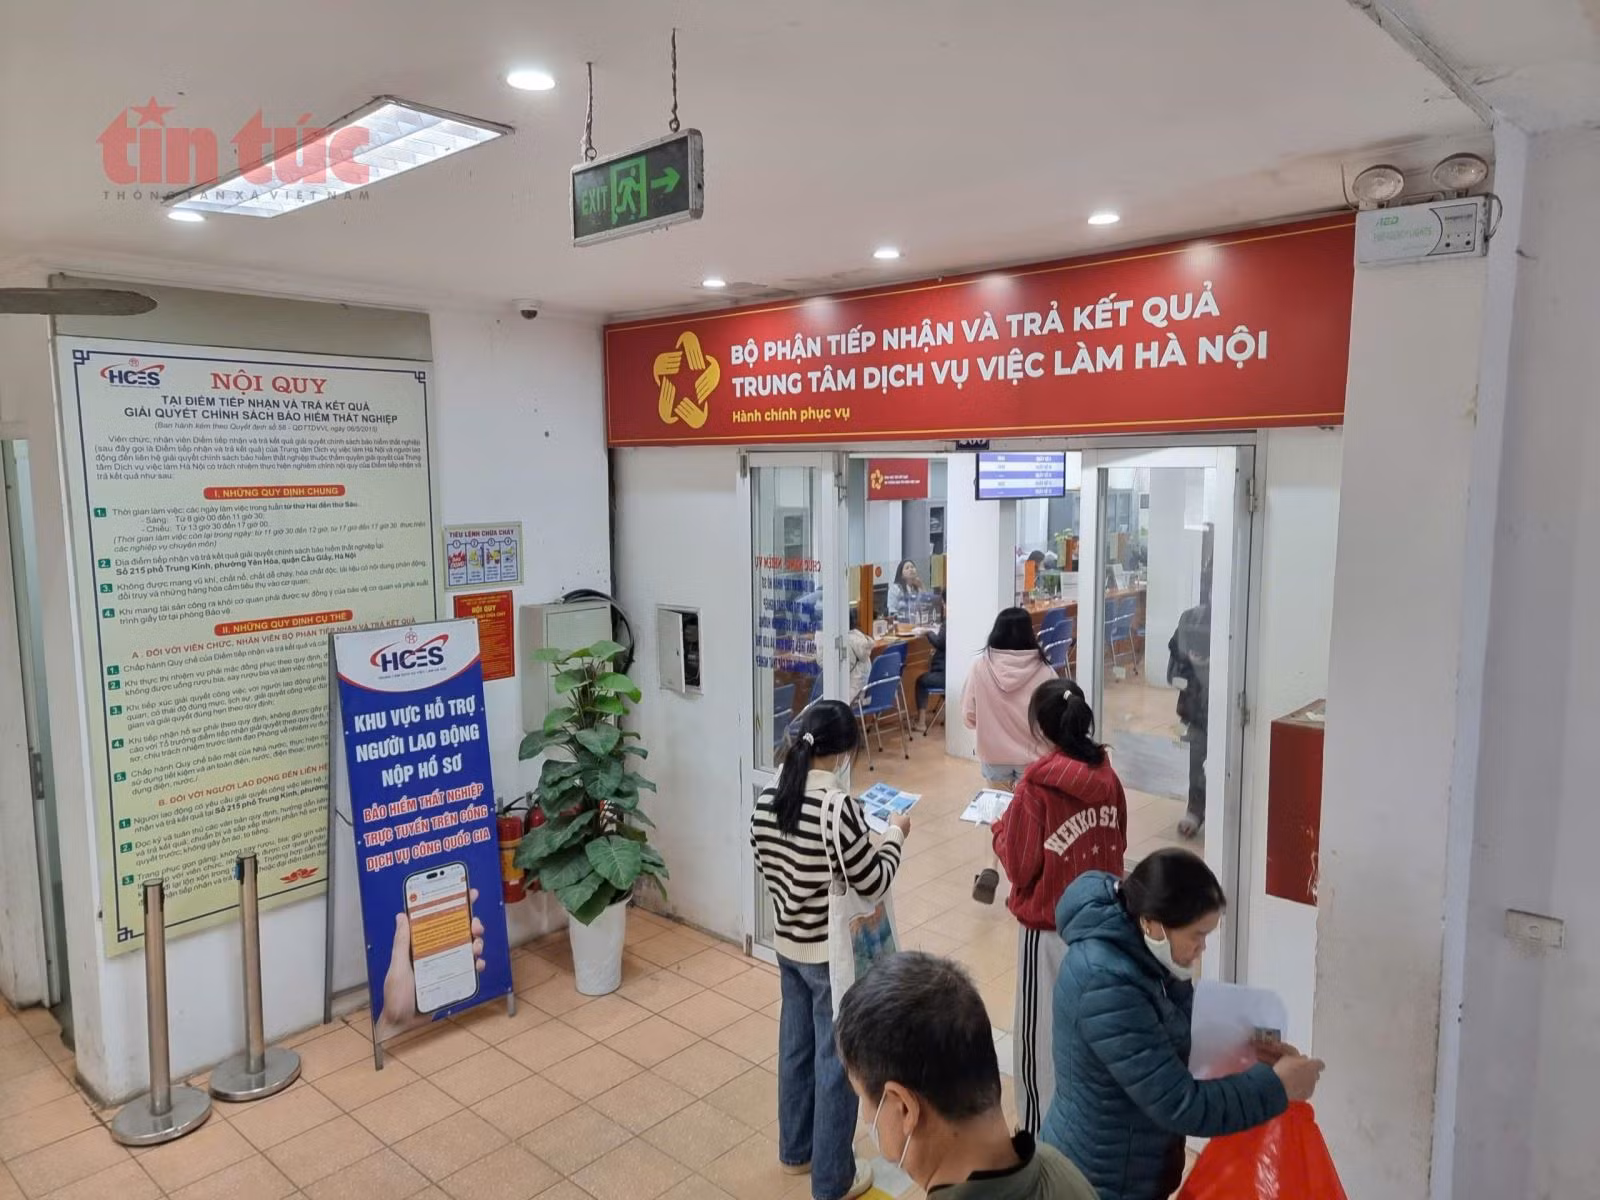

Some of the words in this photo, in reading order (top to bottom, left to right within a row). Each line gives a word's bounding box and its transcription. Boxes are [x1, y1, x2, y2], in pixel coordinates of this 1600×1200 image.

[582, 186, 608, 216] EXIT
[730, 338, 758, 368] BỘ
[764, 333, 821, 364] PHẬN
[827, 324, 876, 355] TIẾP
[882, 318, 954, 353] NHẬN
[961, 311, 999, 342] VÀ
[1006, 300, 1064, 337] TRẢ
[1073, 292, 1134, 331] KẾT
[1142, 280, 1220, 328] QUẢ
[732, 372, 802, 398] TRUNG
[808, 364, 855, 393] TÂM
[863, 363, 924, 394] DỊCH
[931, 358, 969, 390] VỤ
[977, 348, 1045, 385] VIỆC
[1054, 341, 1123, 376] LÀM
[1135, 332, 1187, 369] HÀ
[1198, 324, 1268, 368] NỘI
[109, 370, 160, 385] HCES
[211, 369, 263, 395] NỘI
[272, 375, 328, 394] QUY
[124, 406, 151, 417] GIẢI
[155, 406, 198, 418] QUYẾT
[202, 408, 238, 420] CHÍNH
[242, 409, 274, 420] SÁCH
[277, 410, 300, 421] BẢO
[304, 411, 330, 422] HIỂM
[333, 412, 359, 423] THẤT
[362, 413, 398, 425] NGHIỆP
[161, 395, 181, 407] TẠI
[185, 394, 215, 406] ĐIỂM
[219, 395, 244, 407] TIẾP
[248, 397, 280, 410] NHẬN
[283, 397, 298, 409] VÀ
[301, 398, 322, 410] TRẢ
[326, 399, 345, 411] KẾT
[348, 400, 370, 412] QUẢ
[733, 410, 762, 423] Hành
[764, 408, 796, 422] chính
[801, 406, 831, 422] phục
[834, 406, 850, 420] vụ
[223, 488, 259, 497] NHỮNG
[262, 488, 280, 497] QUY
[284, 488, 304, 497] ĐỊNH
[308, 487, 338, 496] CHUNG
[116, 566, 128, 576] Số
[147, 564, 163, 574] phố
[166, 564, 190, 574] Trung
[214, 559, 246, 571] phường
[248, 556, 262, 566] Yên
[334, 552, 343, 560] Hà
[344, 551, 356, 560] Nội
[233, 620, 268, 633] NHỮNG
[271, 620, 289, 629] QUY
[292, 616, 314, 627] ĐỊNH
[315, 614, 327, 624] CỤ
[330, 610, 346, 621] THỂ
[166, 644, 182, 655] VỚI
[184, 642, 204, 653] VIÊN
[236, 636, 259, 646] NHÂN
[262, 632, 281, 642] VIÊN
[282, 630, 293, 641] BỘ
[296, 629, 317, 640] PHẬN
[381, 646, 444, 672] HCES
[354, 711, 386, 733] KHU
[390, 706, 420, 728] VỰC
[425, 696, 445, 720] HỖ
[448, 695, 476, 716] TRỢ
[356, 735, 404, 762] NGƯỜI
[409, 732, 436, 752] LAO
[440, 724, 480, 747] ĐỘNG
[206, 783, 235, 797] NGƯỜI
[238, 779, 254, 790] LAO
[257, 774, 280, 788] ĐỘNG
[282, 768, 298, 780] ĐẾN
[300, 765, 317, 776] LIÊN
[382, 765, 413, 787] NỘP
[418, 755, 438, 779] HỒ
[443, 754, 462, 774] SƠ
[227, 803, 241, 812] 215
[258, 794, 280, 808] Trung
[363, 803, 386, 823] BẢO
[389, 796, 416, 816] HIỂM
[419, 788, 445, 809] THẤT
[447, 782, 484, 803] NGHIỆP
[364, 828, 393, 847] TRỰC
[395, 818, 430, 839] TUYẾN
[431, 810, 458, 830] TRÊN
[460, 804, 488, 823] CỔNG
[1100, 805, 1119, 830] ST
[366, 853, 393, 872] DỊCH
[395, 848, 410, 864] VỤ
[412, 841, 442, 858] CÔNG
[443, 830, 471, 851] QUỐC
[473, 827, 491, 843] GIA
